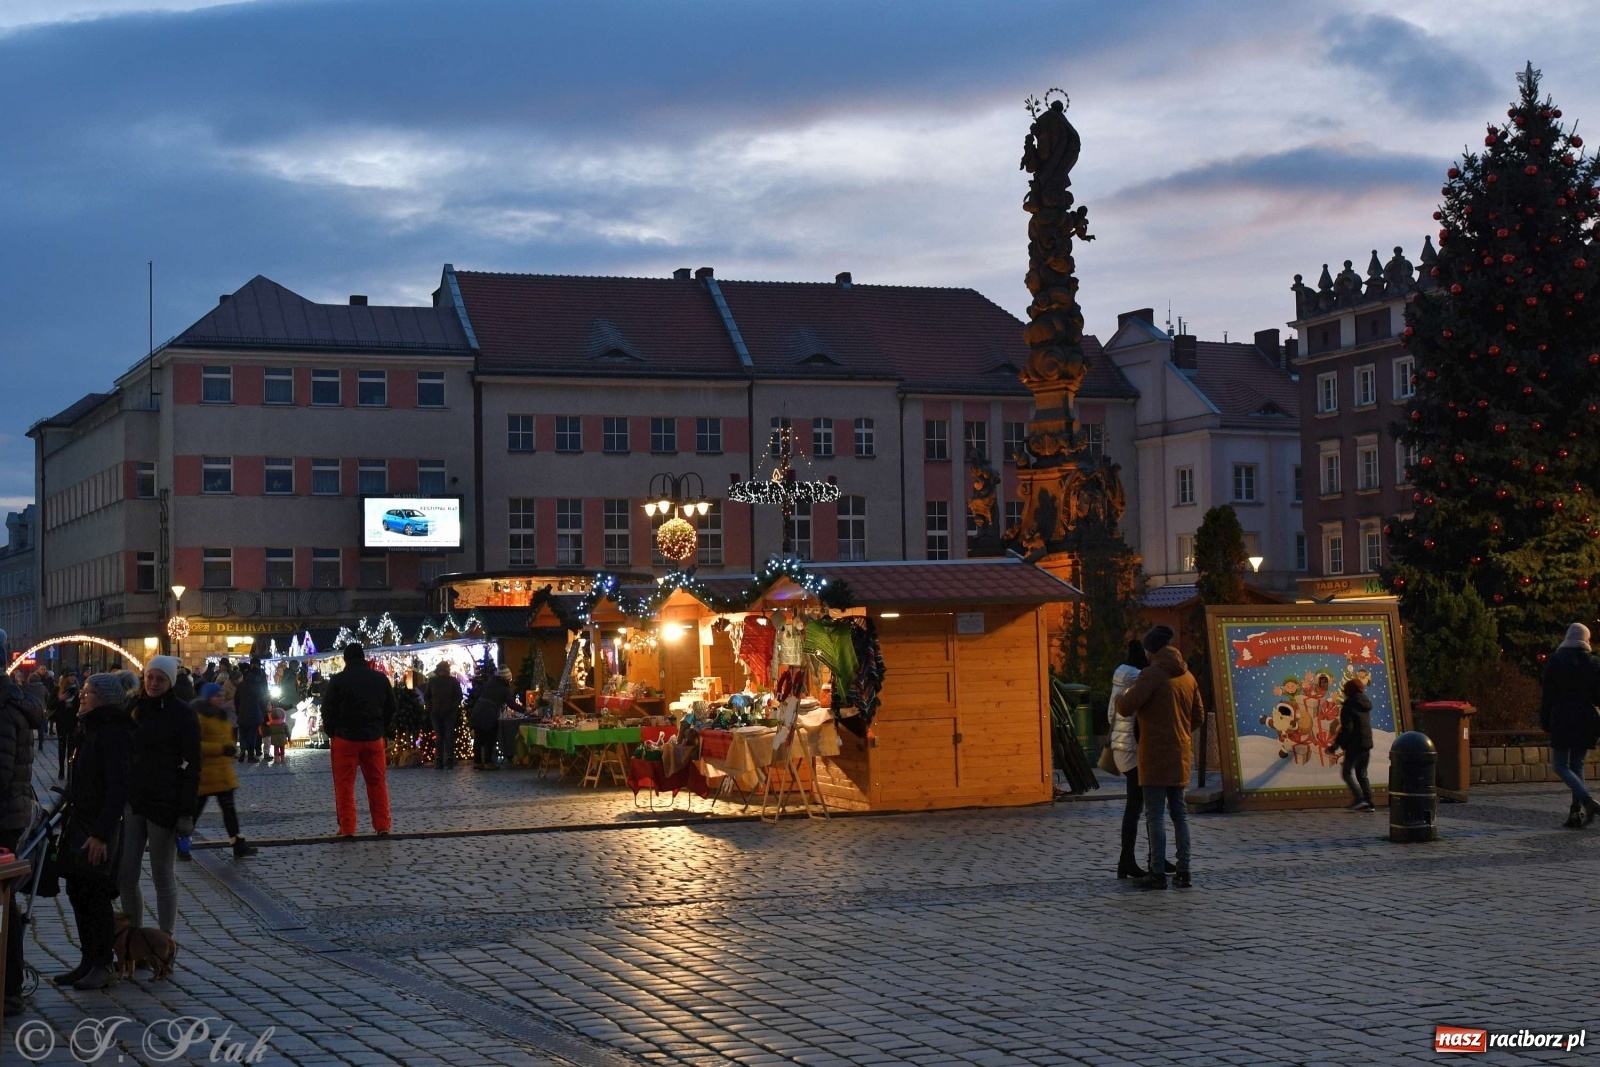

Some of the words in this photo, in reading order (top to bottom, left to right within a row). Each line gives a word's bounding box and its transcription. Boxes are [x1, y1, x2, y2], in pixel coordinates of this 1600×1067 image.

[1316, 581, 1349, 590] TABAC
[203, 591, 339, 617] BOLKO
[216, 622, 303, 633] DELIKATESY
[1258, 635, 1300, 646] Świąteczne
[1302, 634, 1352, 644] pozdrowienia
